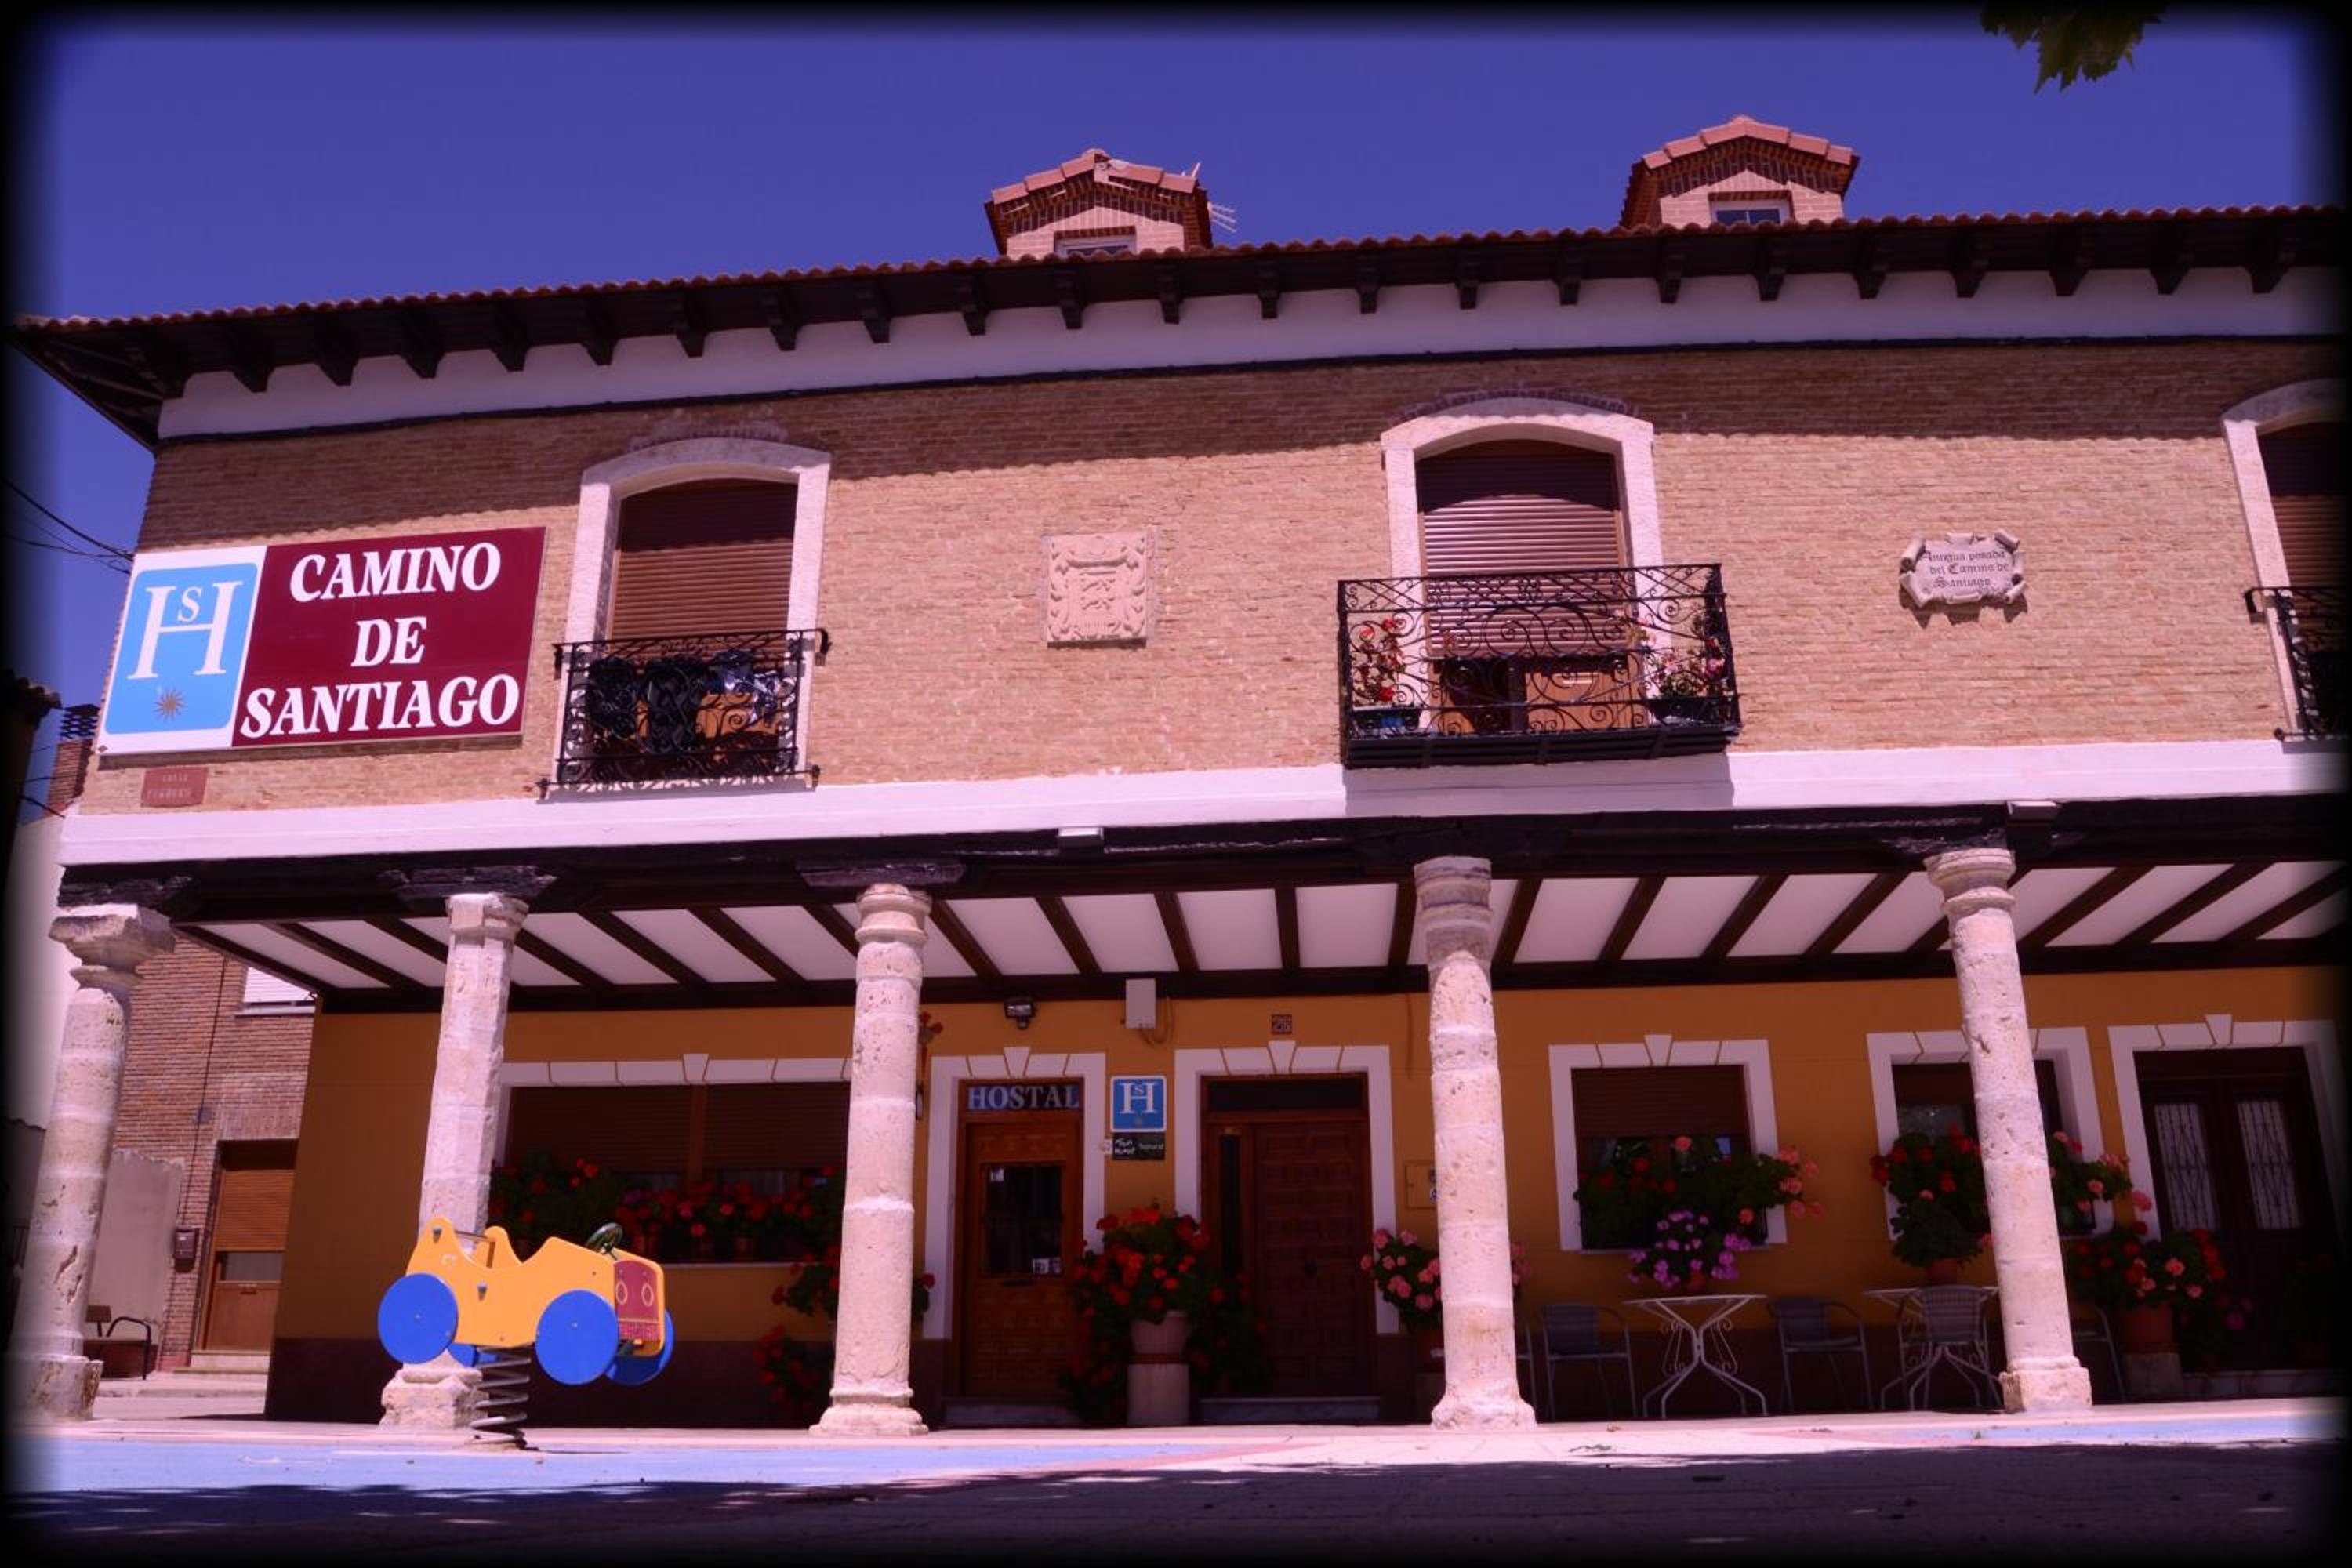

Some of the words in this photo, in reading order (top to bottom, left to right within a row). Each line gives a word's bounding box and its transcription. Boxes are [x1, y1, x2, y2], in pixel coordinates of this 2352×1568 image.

[1969, 550, 2005, 561] posada
[290, 542, 502, 602] CAMINO
[1929, 565, 1946, 575] del
[1947, 563, 1995, 575] Camino
[1997, 563, 2009, 572] de
[1933, 576, 1991, 588] Santiago
[350, 615, 428, 667] DE
[240, 673, 520, 738] SANTIAGO
[967, 1085, 1080, 1110] HOSTAL
